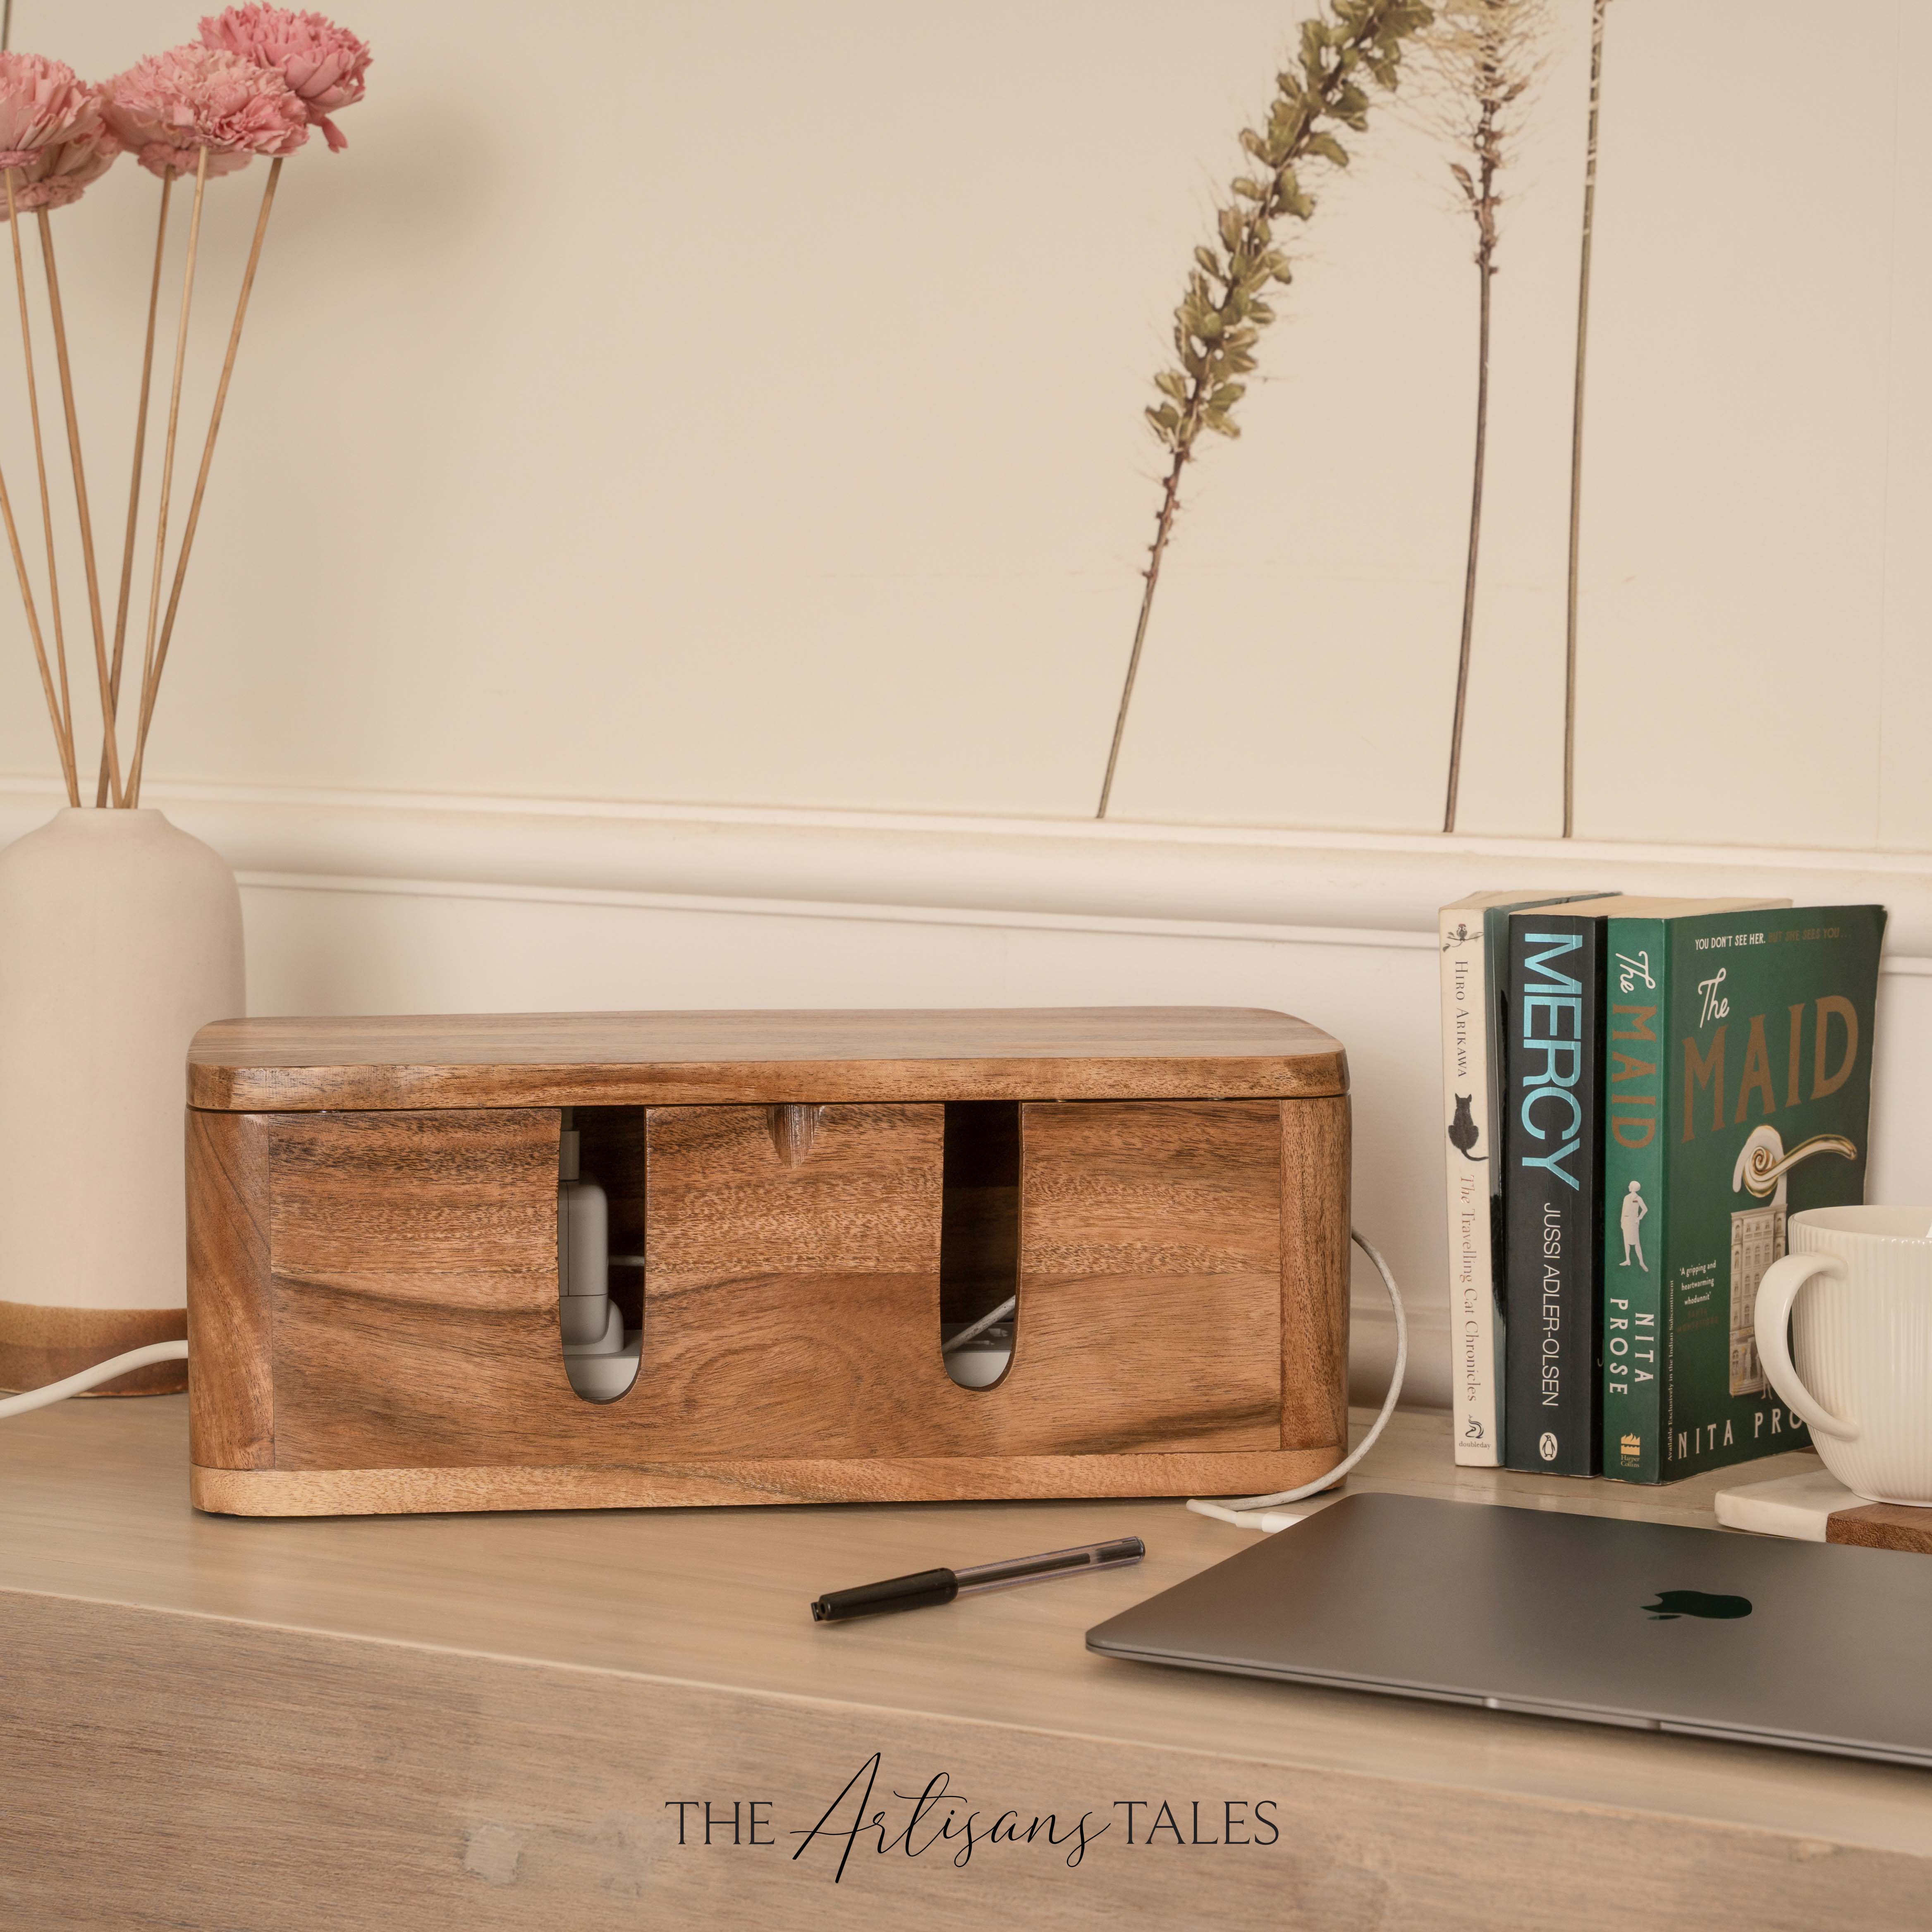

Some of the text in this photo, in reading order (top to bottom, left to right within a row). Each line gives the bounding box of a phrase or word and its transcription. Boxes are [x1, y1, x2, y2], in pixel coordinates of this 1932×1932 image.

[1695, 938, 1709, 950] YOU
[1711, 936, 1732, 948] DON'T
[1735, 935, 1747, 946] SEE
[1749, 933, 1765, 944] HER.
[1768, 931, 1782, 943] BUT
[1455, 961, 1469, 1077] HIRO ARIKAWA
[1698, 967, 1729, 1028] The
[1521, 933, 1583, 1191] MERCY
[1612, 951, 1657, 1149] The MAID
[1681, 995, 1858, 1144] MAID
[1460, 1174, 1481, 1401] The Travelling Cat Chronicles
[1681, 1277, 1714, 1291] heartwarming
[1684, 1291, 1711, 1305] whodunnit'
[1686, 1263, 1706, 1277] gripping
[1707, 1260, 1716, 1270] and
[1542, 1203, 1561, 1406] JUSSI ADLER-OLSEN
[1609, 1298, 1628, 1394] PROSE
[1635, 1313, 1654, 1382] NITA
[1459, 1441, 1491, 1449] doubleday
[1678, 1408, 1804, 1459] NITA PRO
